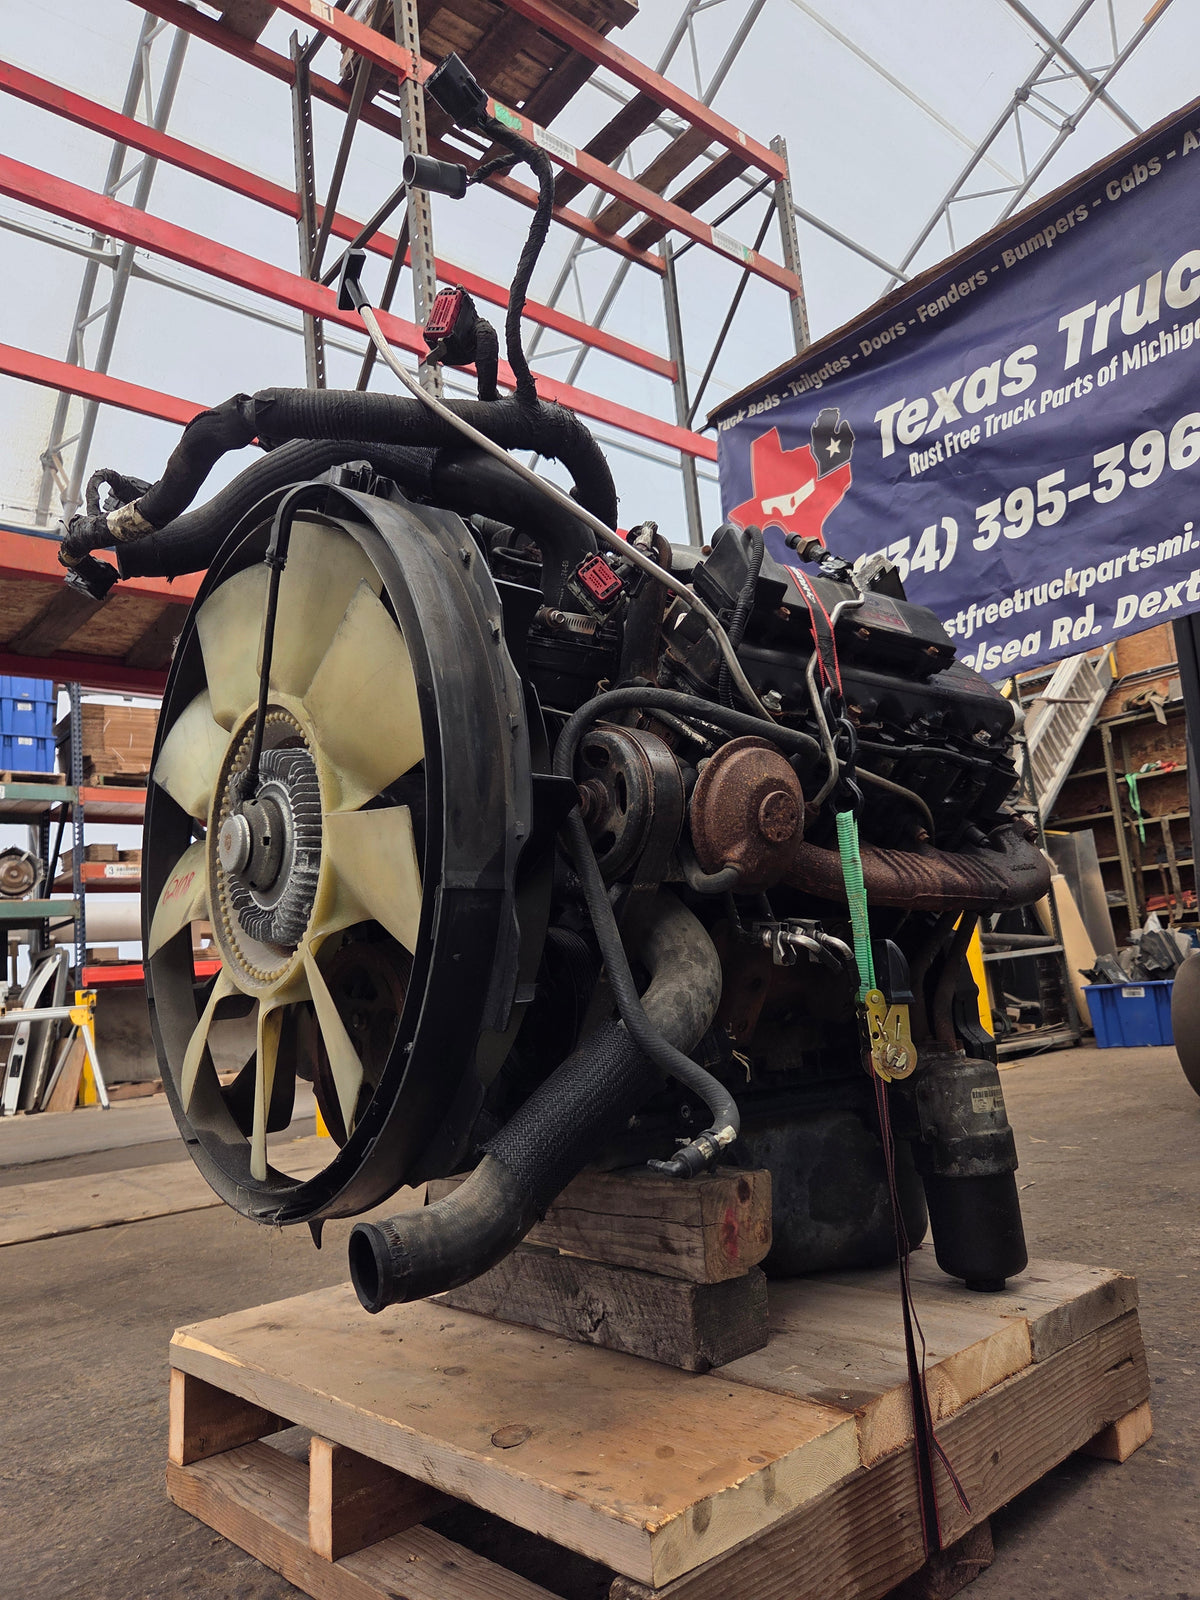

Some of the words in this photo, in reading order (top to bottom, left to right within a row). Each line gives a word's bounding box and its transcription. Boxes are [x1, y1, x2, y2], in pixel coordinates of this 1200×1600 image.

[747, 393, 780, 418] Beds
[787, 355, 851, 397] Tailgates
[859, 321, 906, 357] Doors
[916, 269, 988, 323] Fenders
[1001, 204, 1089, 269] Bumpers
[1105, 155, 1162, 201] Cabs
[1182, 128, 1200, 157] A
[873, 344, 1038, 459] Texas
[1058, 249, 1200, 371] Truc
[908, 440, 944, 478] Rust
[944, 424, 981, 458] Free
[984, 398, 1036, 438] Truck
[1039, 374, 1093, 414] Parts
[1097, 355, 1119, 387] of
[972, 412, 1200, 551] 395-396
[941, 521, 1200, 640] stfreetruckpartsmi.
[1049, 603, 1102, 650] Rd.
[1112, 568, 1200, 629] Dext
